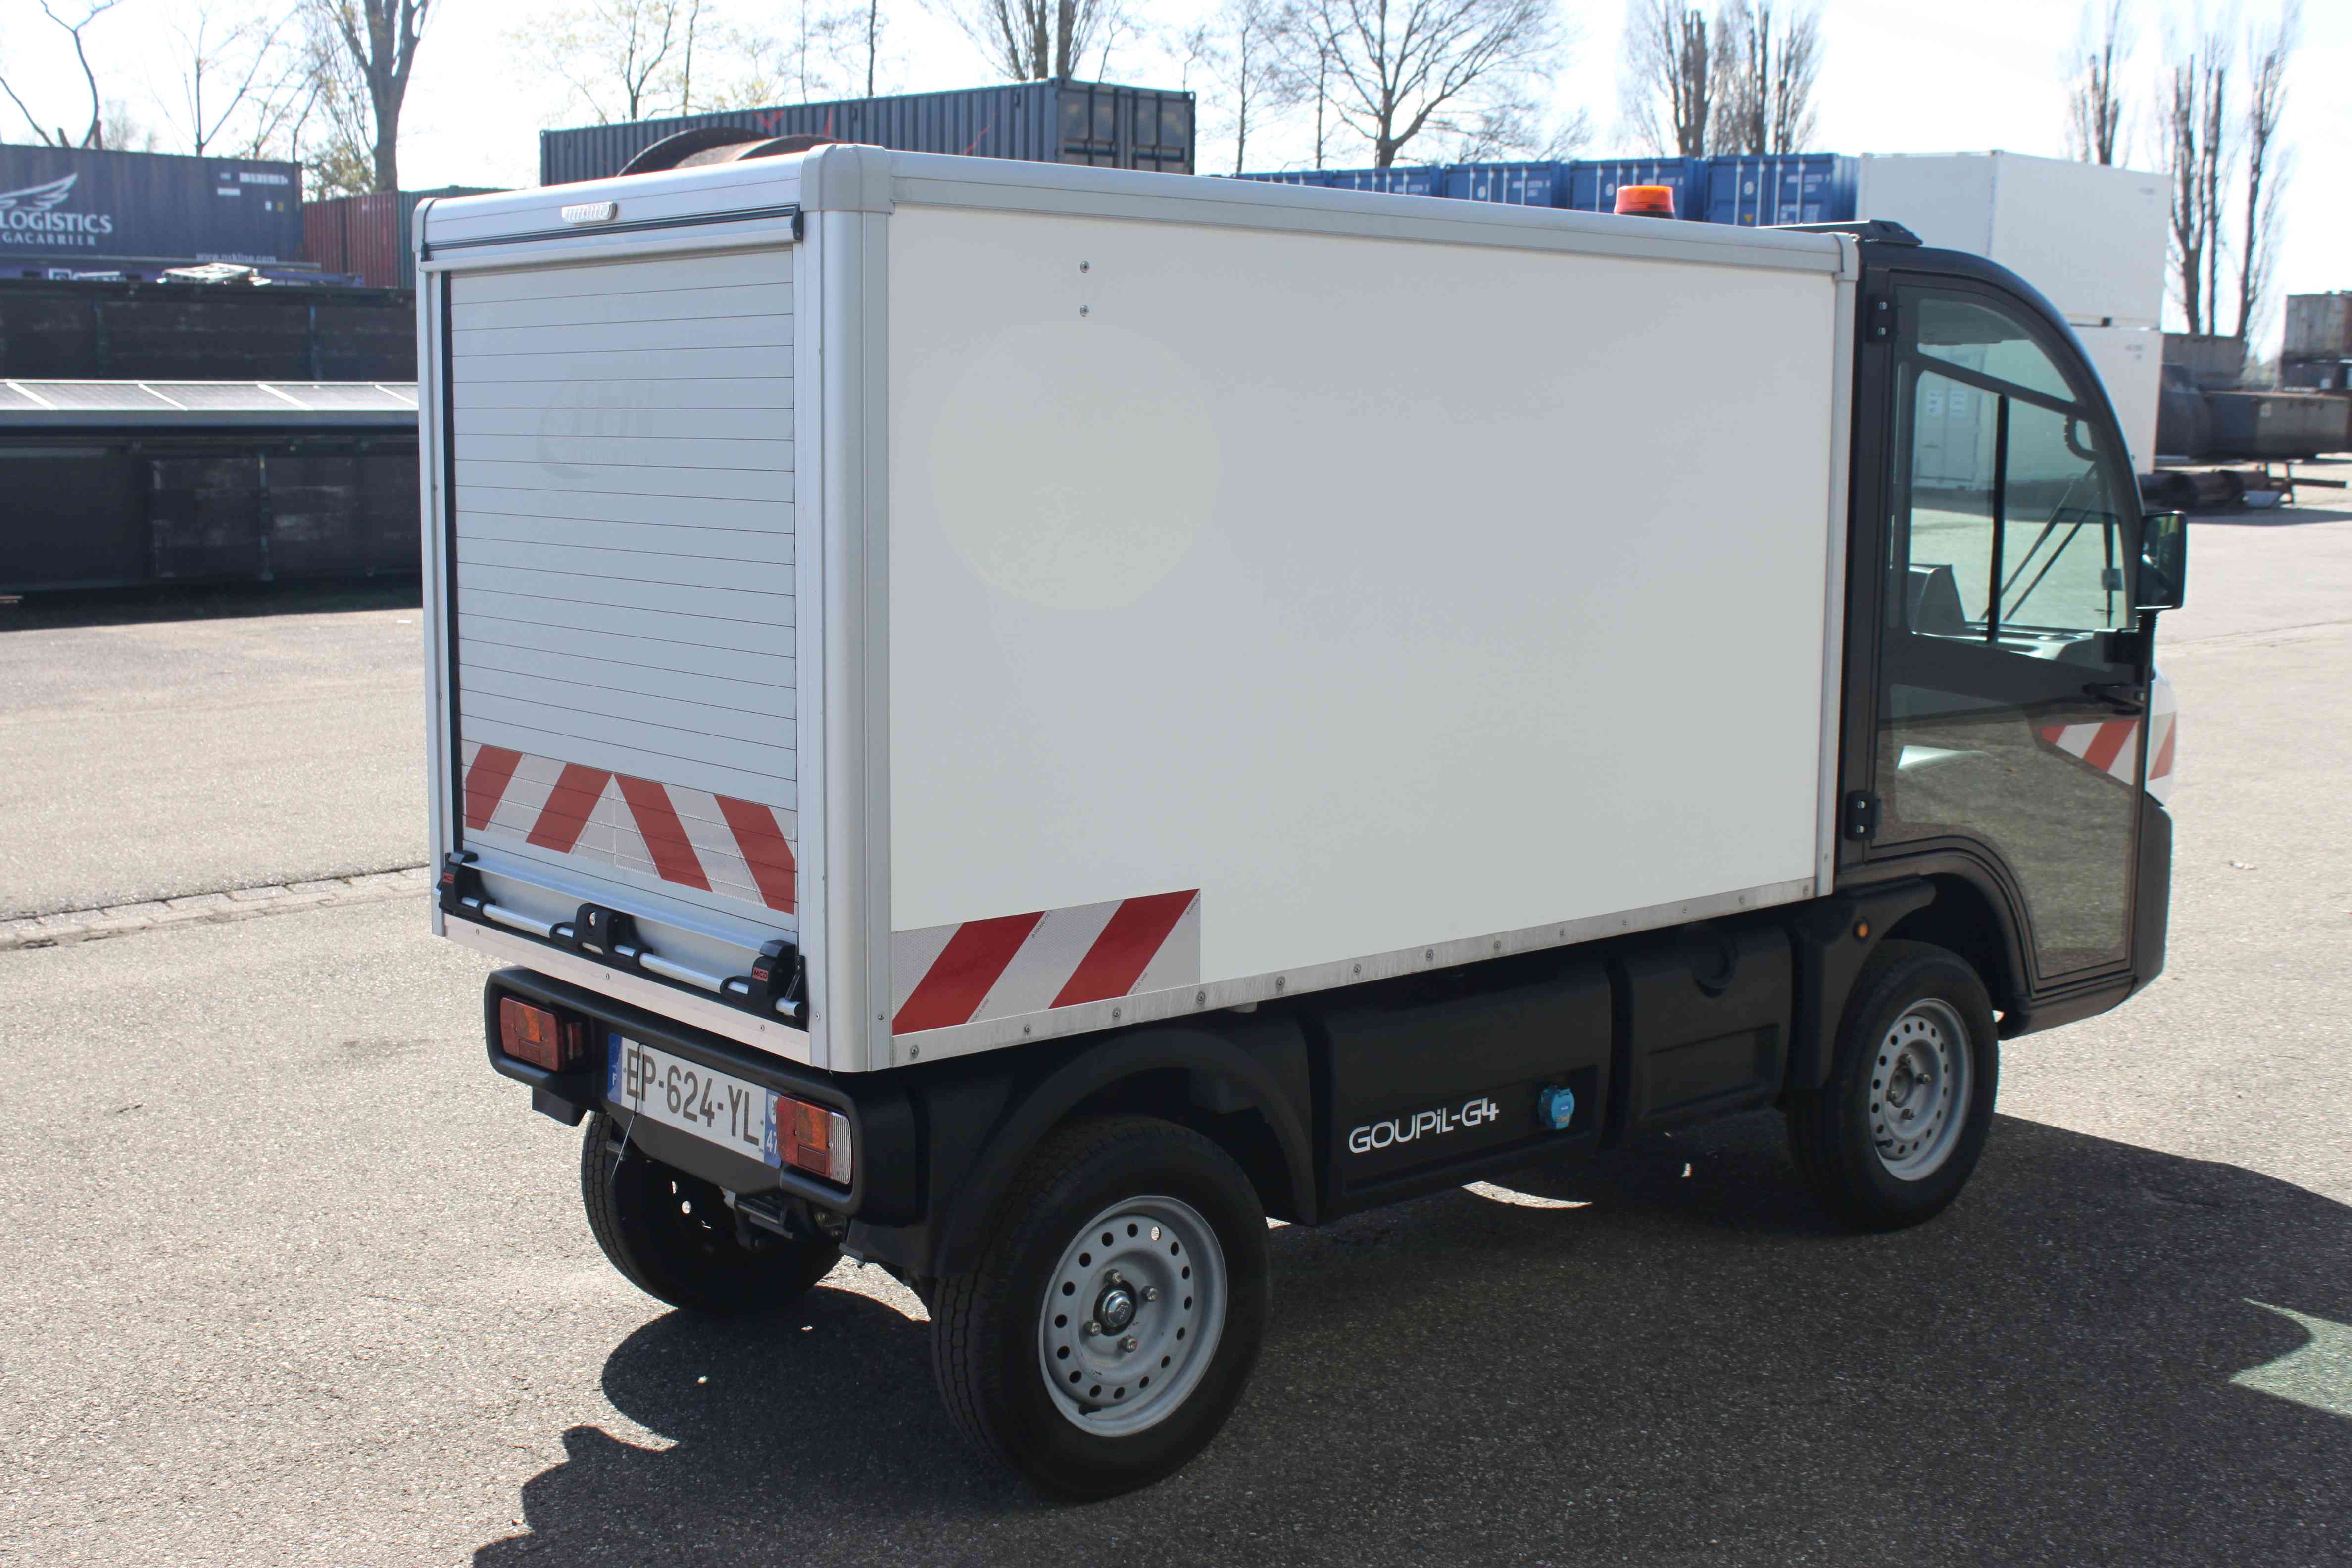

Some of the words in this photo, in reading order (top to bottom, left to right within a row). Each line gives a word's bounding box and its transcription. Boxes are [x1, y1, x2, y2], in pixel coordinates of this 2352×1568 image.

[0, 210, 113, 234] LOGISTICS
[753, 969, 768, 980] MCD
[612, 1073, 617, 1085] F
[627, 1048, 760, 1146] EP-624-YL
